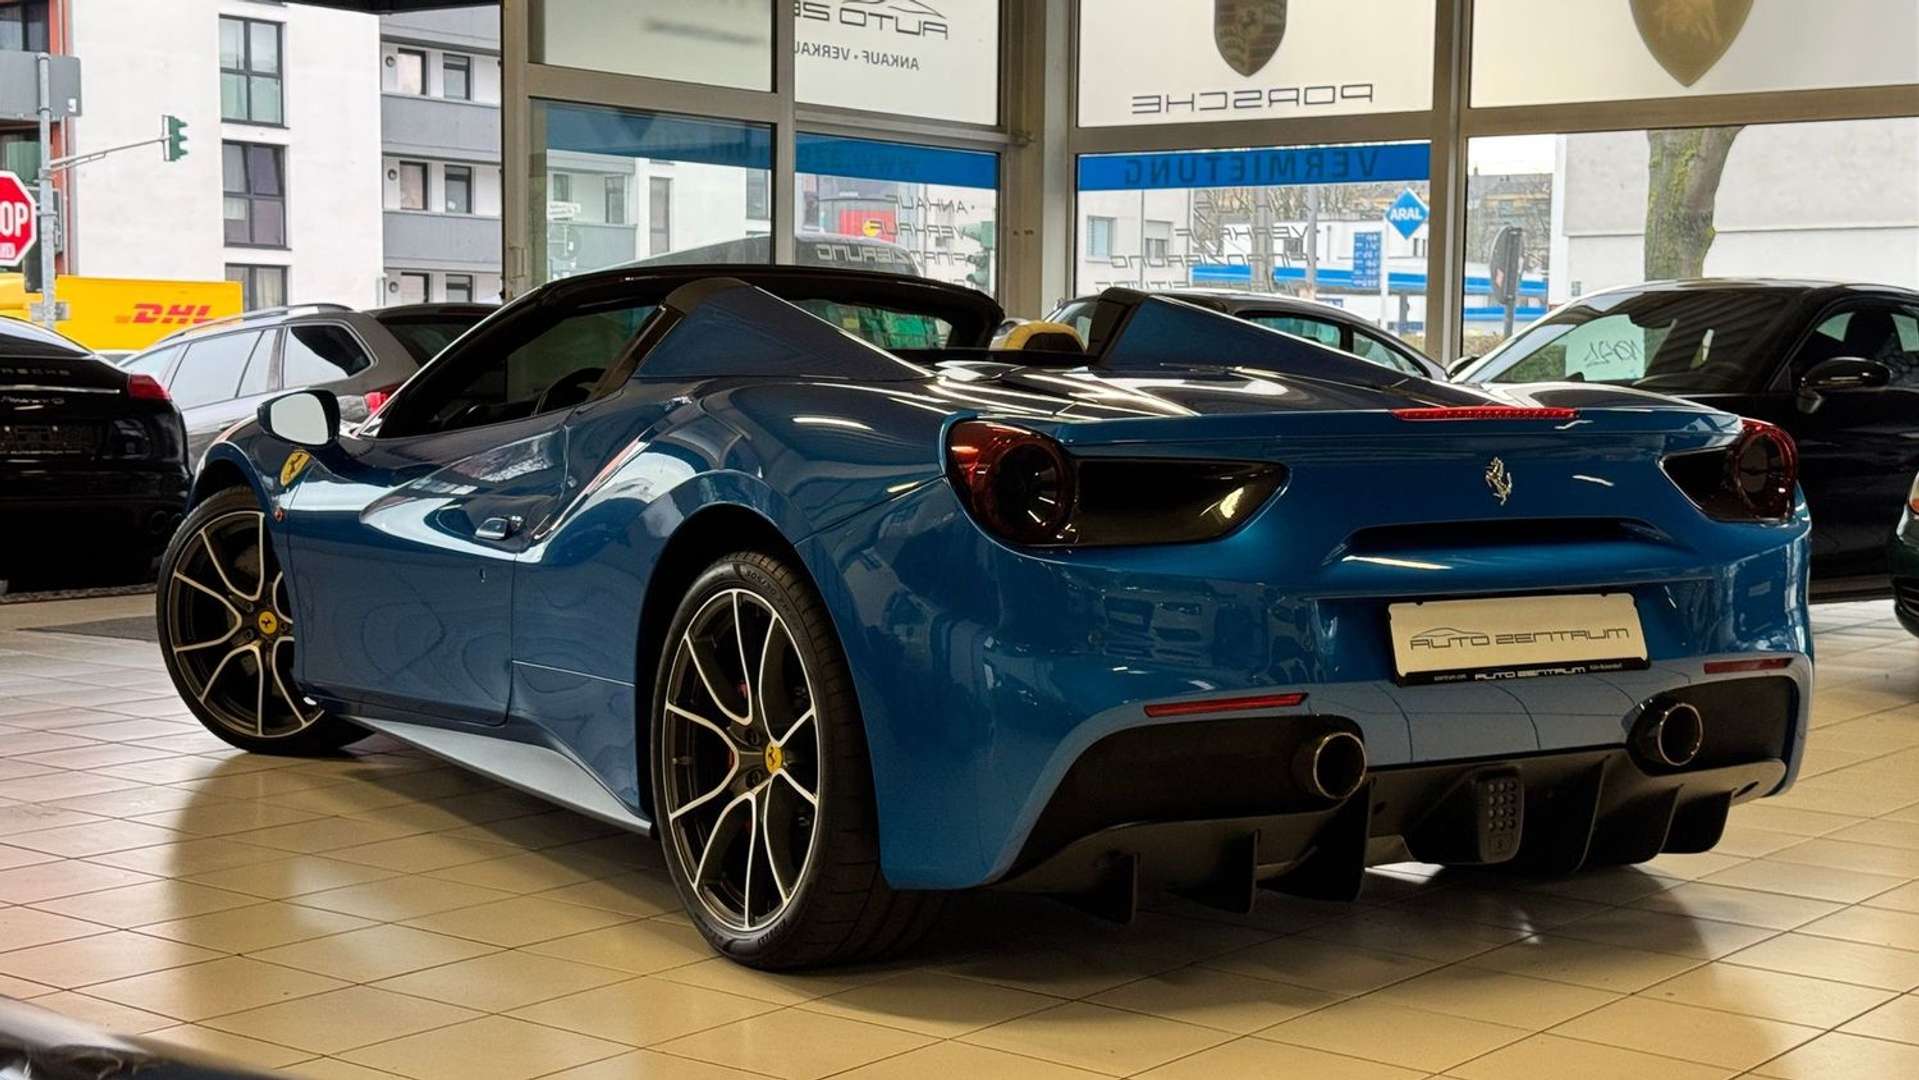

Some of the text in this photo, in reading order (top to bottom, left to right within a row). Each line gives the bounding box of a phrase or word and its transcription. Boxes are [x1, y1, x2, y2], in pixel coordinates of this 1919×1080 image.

[0, 200, 29, 238] OP
[1390, 207, 1424, 221] ARAL
[132, 303, 213, 324] DHL
[1410, 628, 1630, 650] AUTO ZENTRUM
[1474, 672, 1516, 680] AUTO
